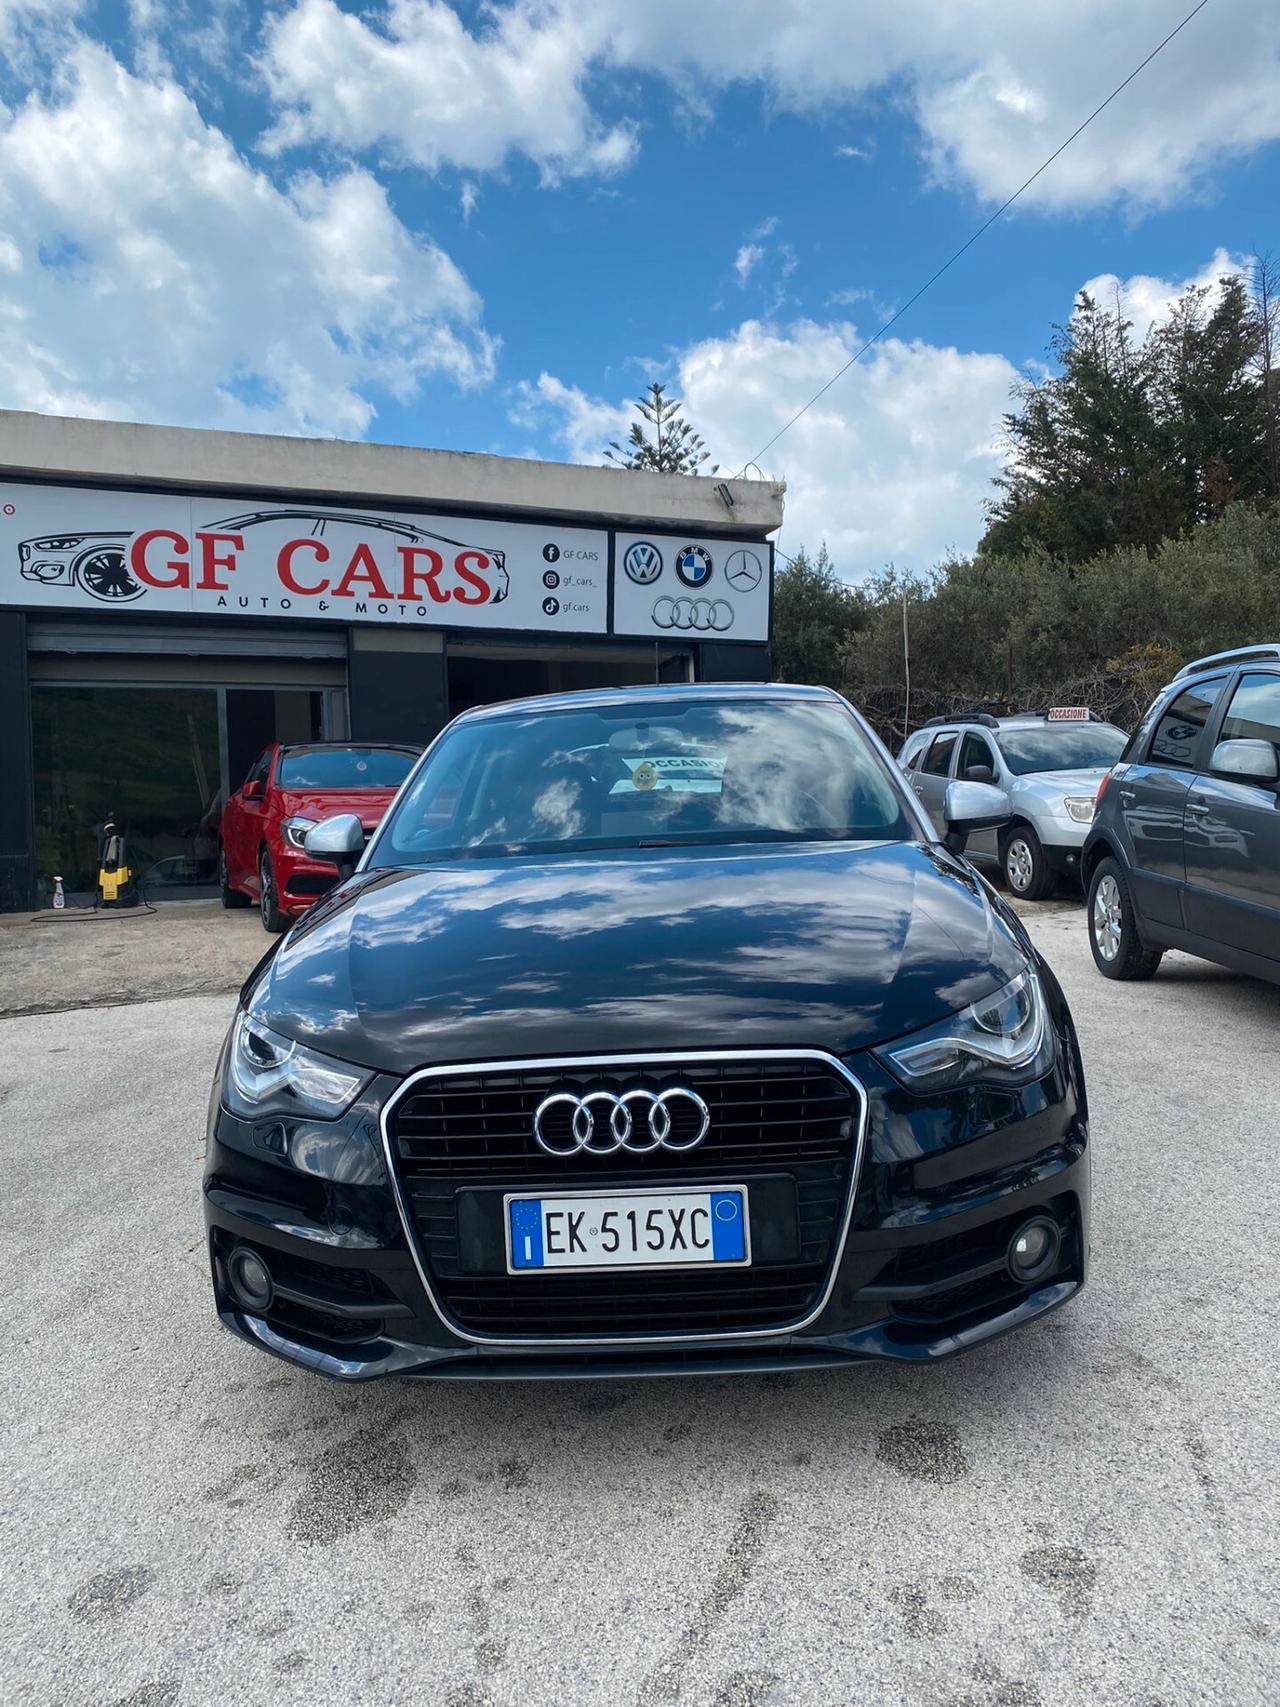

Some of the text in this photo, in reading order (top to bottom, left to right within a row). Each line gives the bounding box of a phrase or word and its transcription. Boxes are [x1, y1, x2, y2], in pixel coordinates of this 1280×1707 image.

[563, 550, 599, 562] GF CARS
[131, 529, 492, 607] GF CARS
[563, 576, 600, 588] gf_cars_
[217, 595, 428, 617] AUTO & MOTO
[1050, 707, 1087, 720] OCCASIONE
[544, 1207, 711, 1255] EK 515XC
